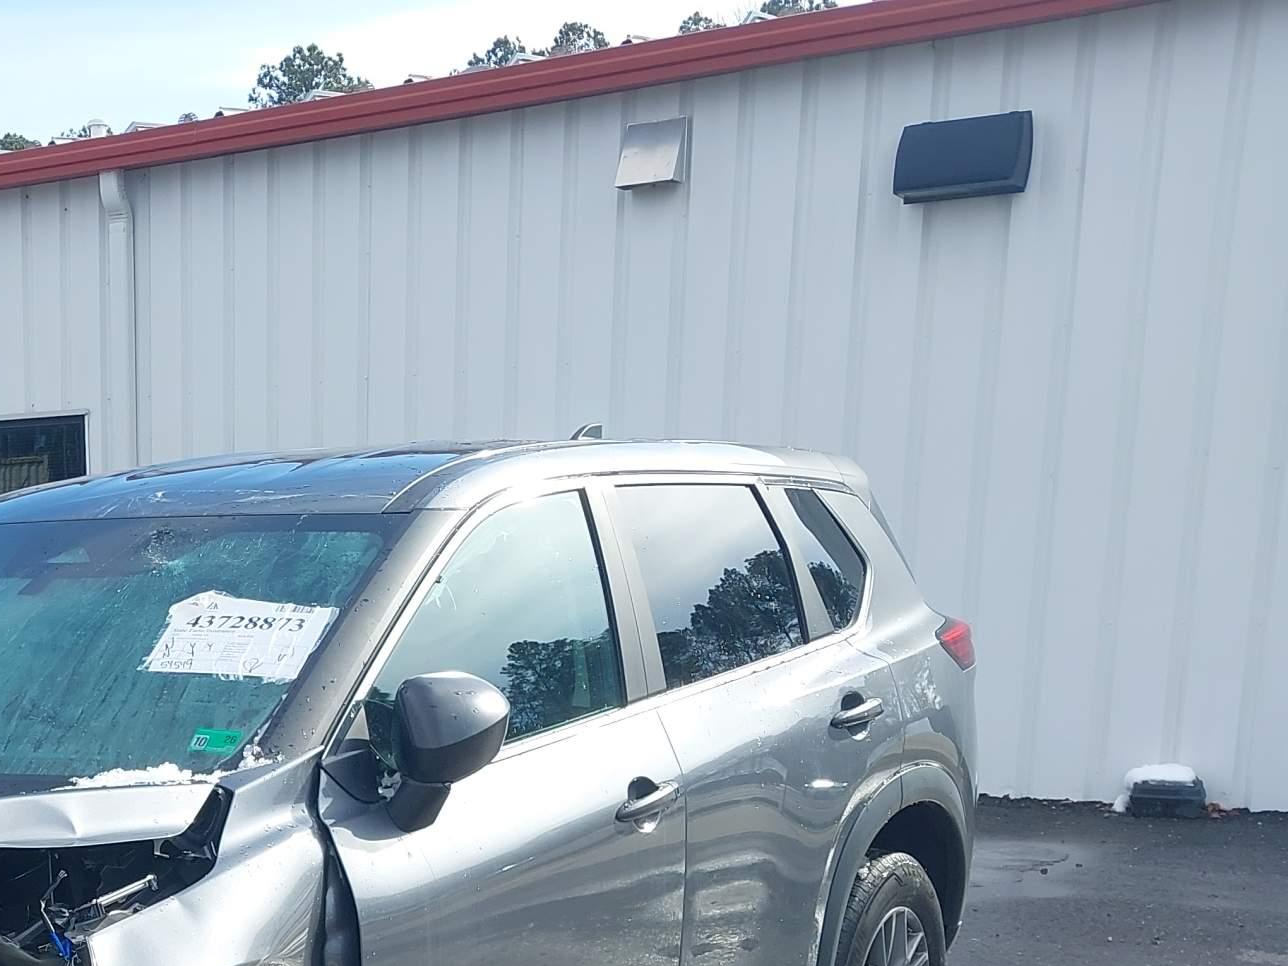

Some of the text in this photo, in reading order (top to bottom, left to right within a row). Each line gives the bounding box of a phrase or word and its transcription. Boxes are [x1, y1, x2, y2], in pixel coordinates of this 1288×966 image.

[186, 615, 306, 632] 43728873
[193, 735, 238, 747] 10 26
